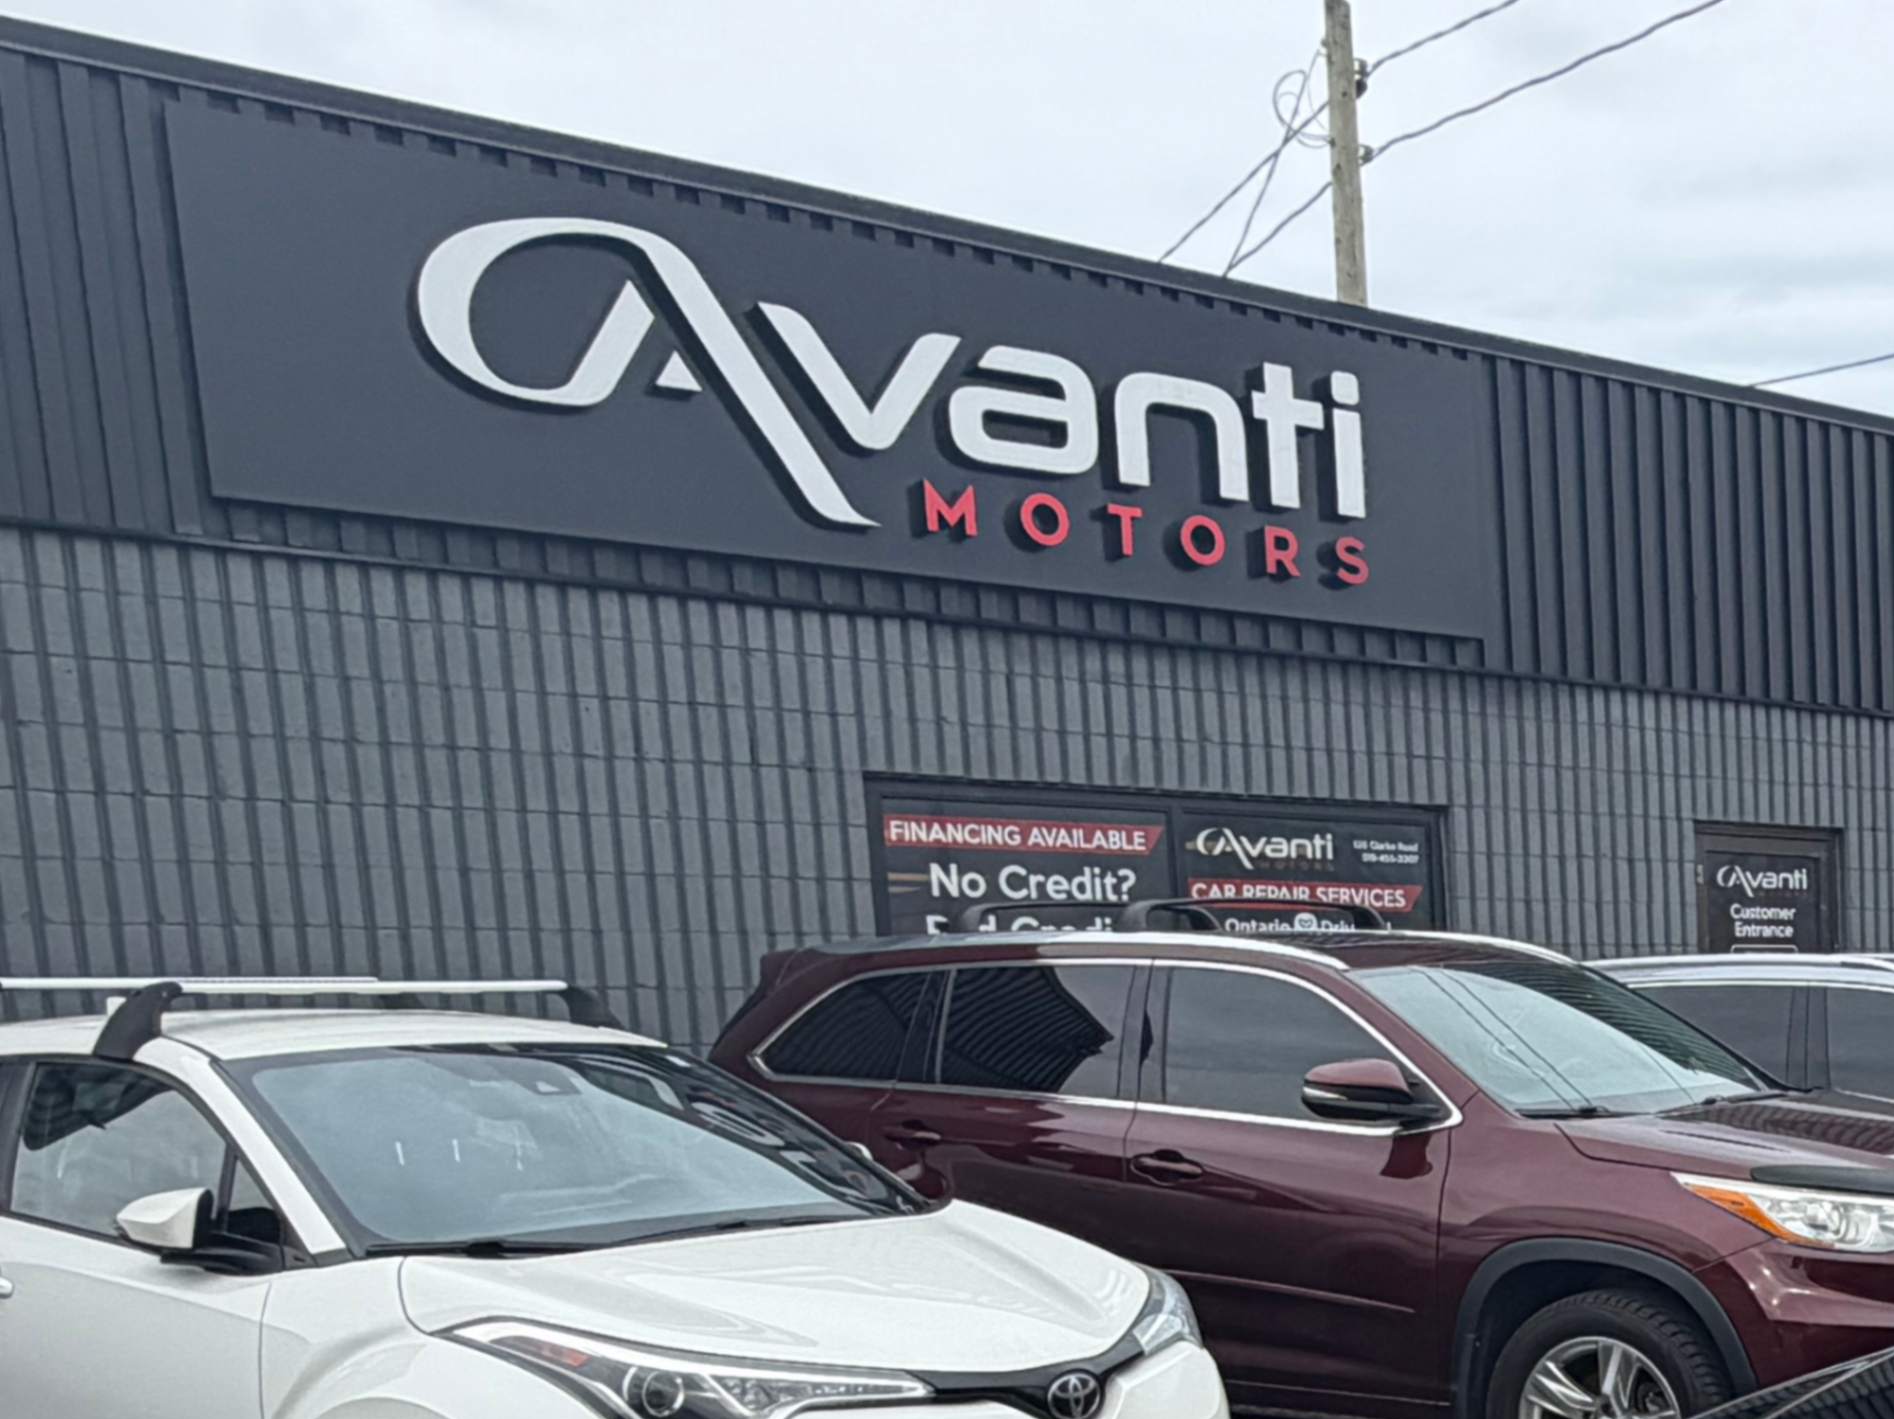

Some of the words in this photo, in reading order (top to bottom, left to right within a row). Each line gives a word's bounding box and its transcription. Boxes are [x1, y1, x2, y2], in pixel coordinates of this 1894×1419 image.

[418, 216, 1367, 527] Avanti
[922, 479, 1371, 585] MOTORS
[889, 820, 1022, 846] FINANCING
[1027, 828, 1147, 850] AVAILABLE
[1196, 827, 1334, 870] Avanti
[929, 863, 987, 898] No
[999, 865, 1137, 901] Credit?
[1191, 882, 1238, 899] CAR
[1242, 884, 1311, 901] REPAIR
[1316, 887, 1406, 907] SERVICES
[1717, 865, 1808, 898] Avanti
[1730, 903, 1796, 920] Customer
[1735, 921, 1794, 938] Entrance
